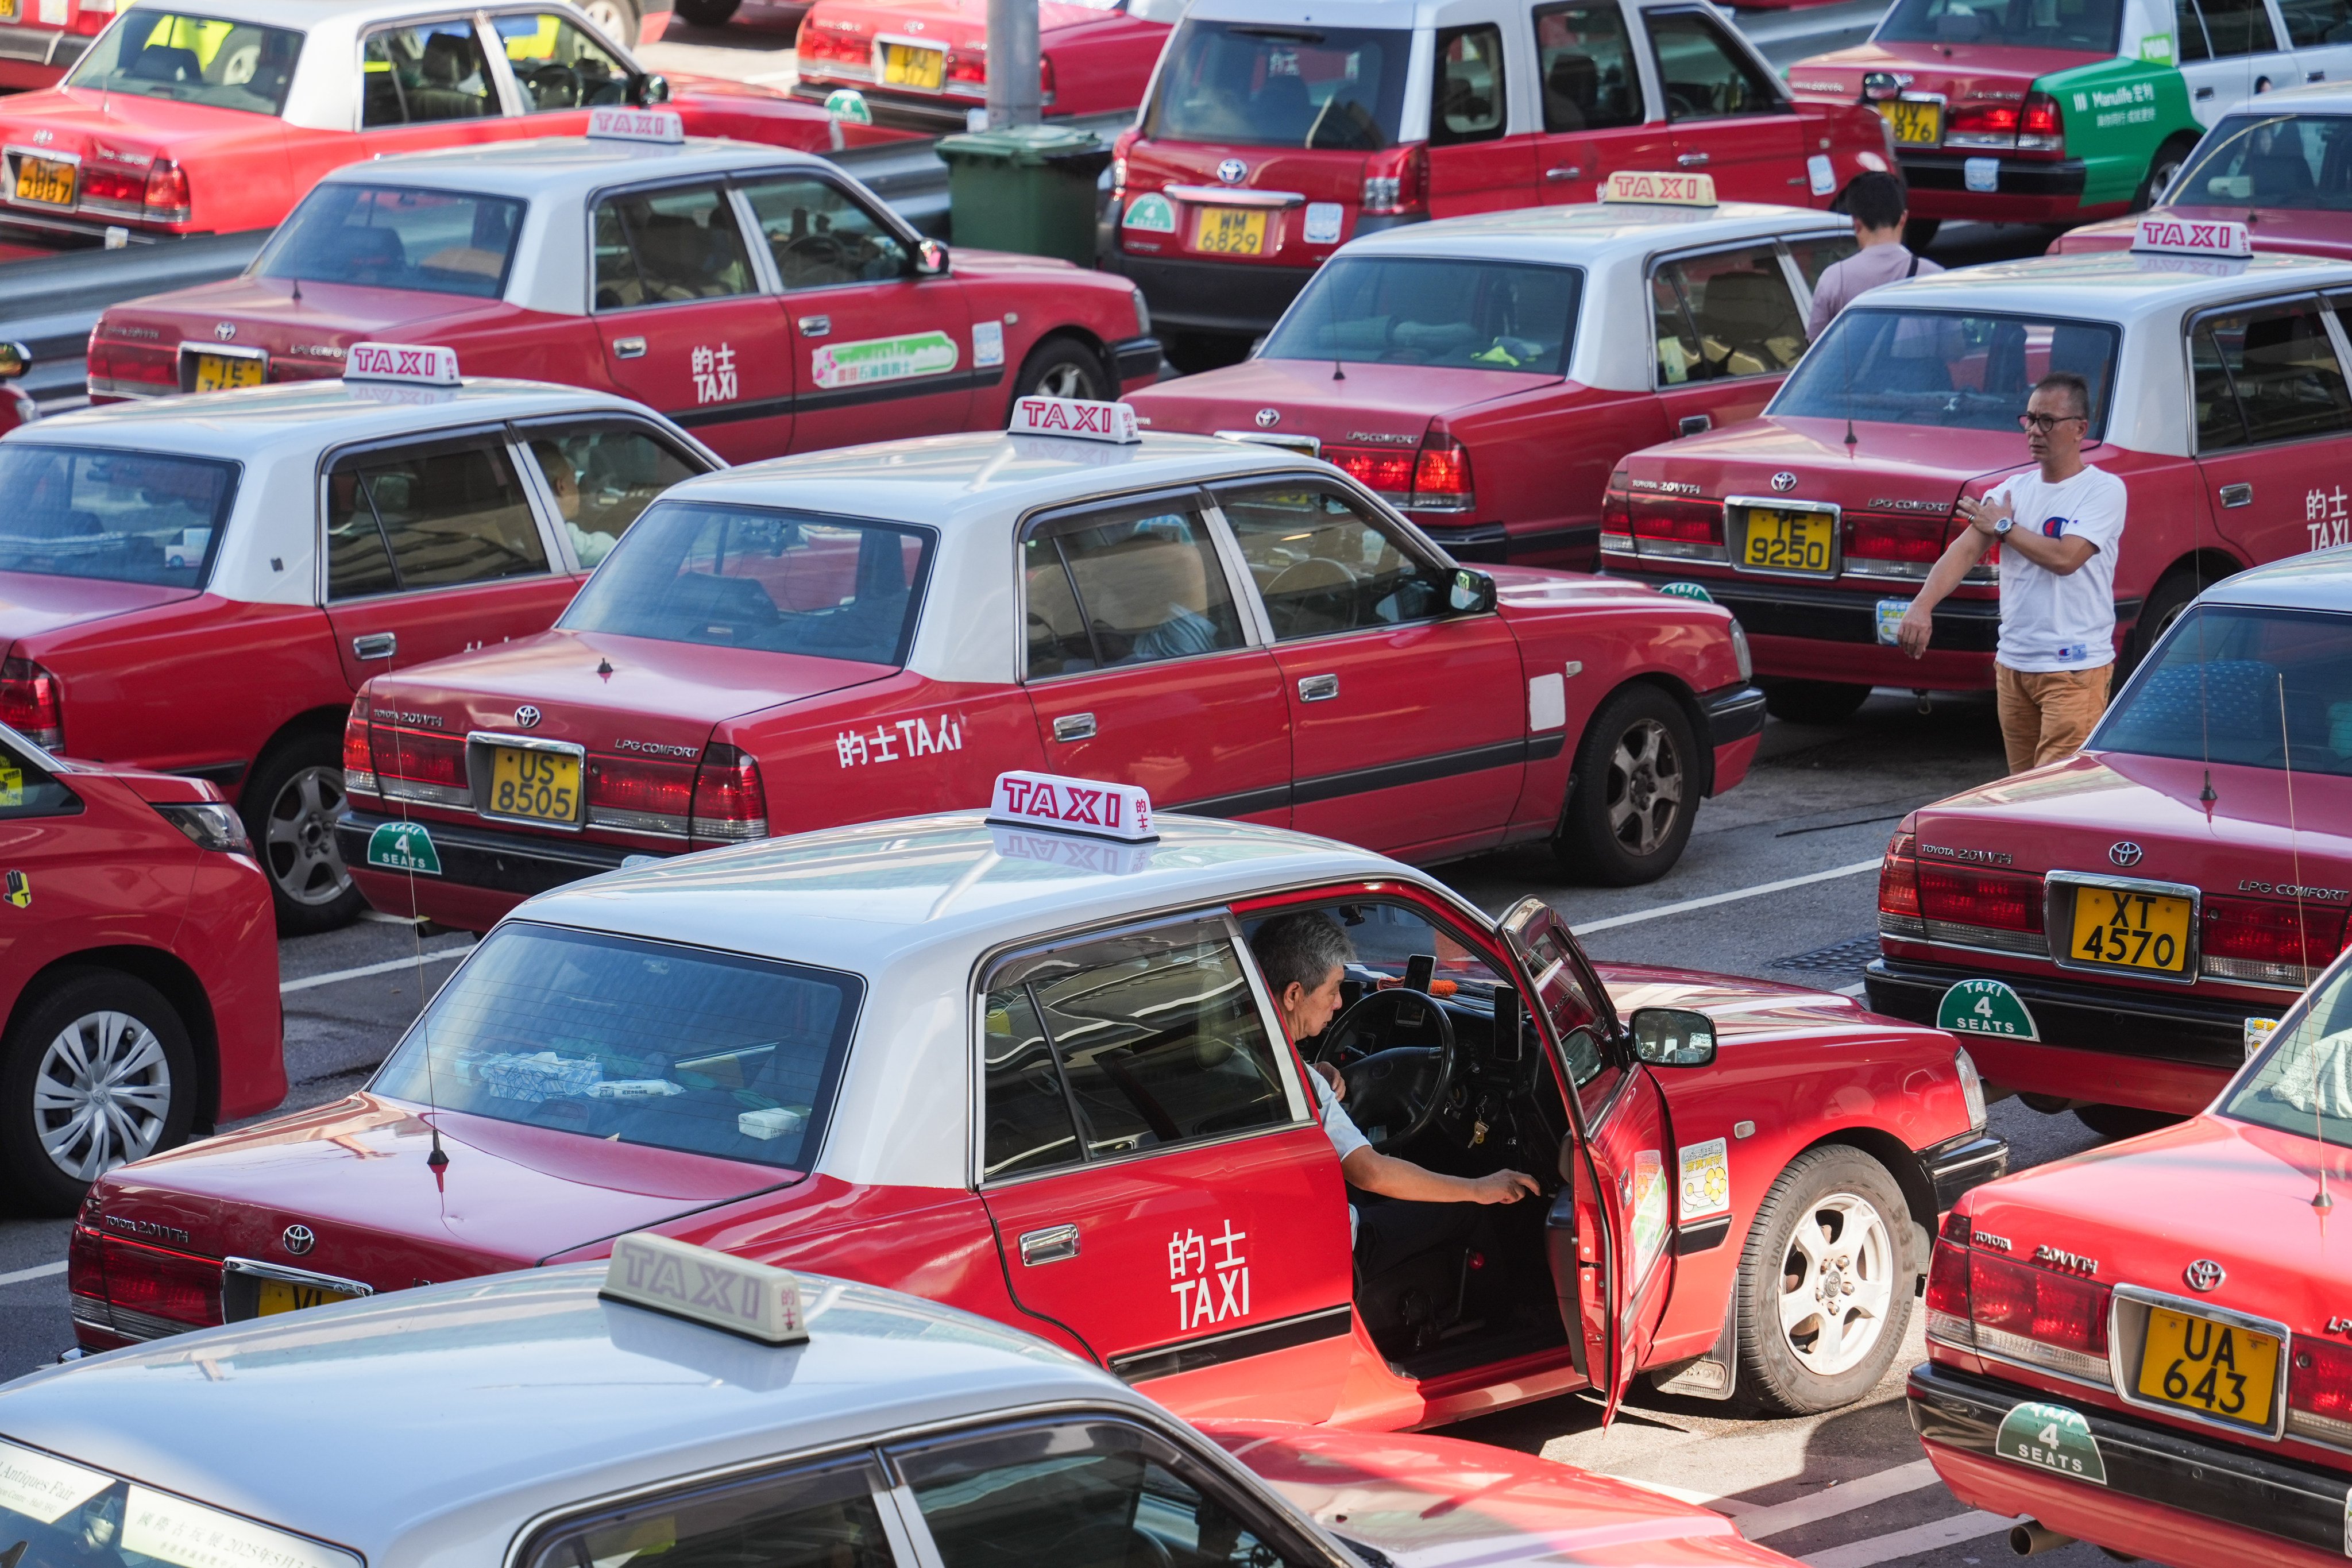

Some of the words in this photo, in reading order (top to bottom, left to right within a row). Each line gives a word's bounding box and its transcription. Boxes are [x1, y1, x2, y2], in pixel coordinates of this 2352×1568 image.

[2092, 86, 2133, 108] Manulife
[596, 111, 665, 136] TAXI
[1615, 176, 1697, 200] TAXI
[1220, 212, 1246, 230] WM
[1203, 231, 1258, 254] 6829
[2143, 222, 2230, 249] TAXI
[355, 349, 435, 377] TAXI
[692, 342, 736, 374] 的士
[693, 370, 737, 404] TAXI
[1022, 401, 1111, 433] TAXI
[1632, 480, 1658, 489] TOYOTA
[1867, 498, 1894, 509] LPG
[1895, 499, 1951, 512] COMFORT
[2306, 485, 2348, 521] 的士
[2307, 518, 2349, 551] TAXI
[1751, 537, 1824, 569] 9250
[1669, 585, 1699, 597] TAXI
[374, 709, 399, 720] TOYOTA
[615, 737, 640, 751] LPG
[642, 741, 700, 758] COMFORT
[519, 748, 555, 785] US
[498, 781, 571, 818] 8505
[1003, 778, 1121, 828] TAXI
[1136, 798, 1148, 828] 的士
[395, 834, 408, 855] 4
[1922, 844, 1954, 856] TOYOTA
[382, 852, 426, 868] SEATS
[2238, 879, 2272, 893] LPG
[2275, 884, 2350, 901] COMFORT
[2108, 892, 2157, 929] XT
[2082, 925, 2175, 967] 4570
[1963, 982, 2003, 997] TAXI
[1973, 996, 1993, 1018] 4
[1957, 1017, 2014, 1033] SEATS
[105, 1215, 136, 1231] TOYOTA
[1168, 1219, 1246, 1280] 的士
[1975, 1230, 2012, 1250] TOYOTA
[621, 1242, 761, 1320] TAXI
[781, 1289, 797, 1327] 的士
[1171, 1266, 1249, 1331] TAXI
[2184, 1318, 2235, 1372] UA
[2163, 1358, 2247, 1414] 643
[2038, 1423, 2059, 1450] 4
[2018, 1443, 2083, 1472] SEATS
[2, 1465, 49, 1491] Antiques
[49, 1480, 75, 1501] Fair
